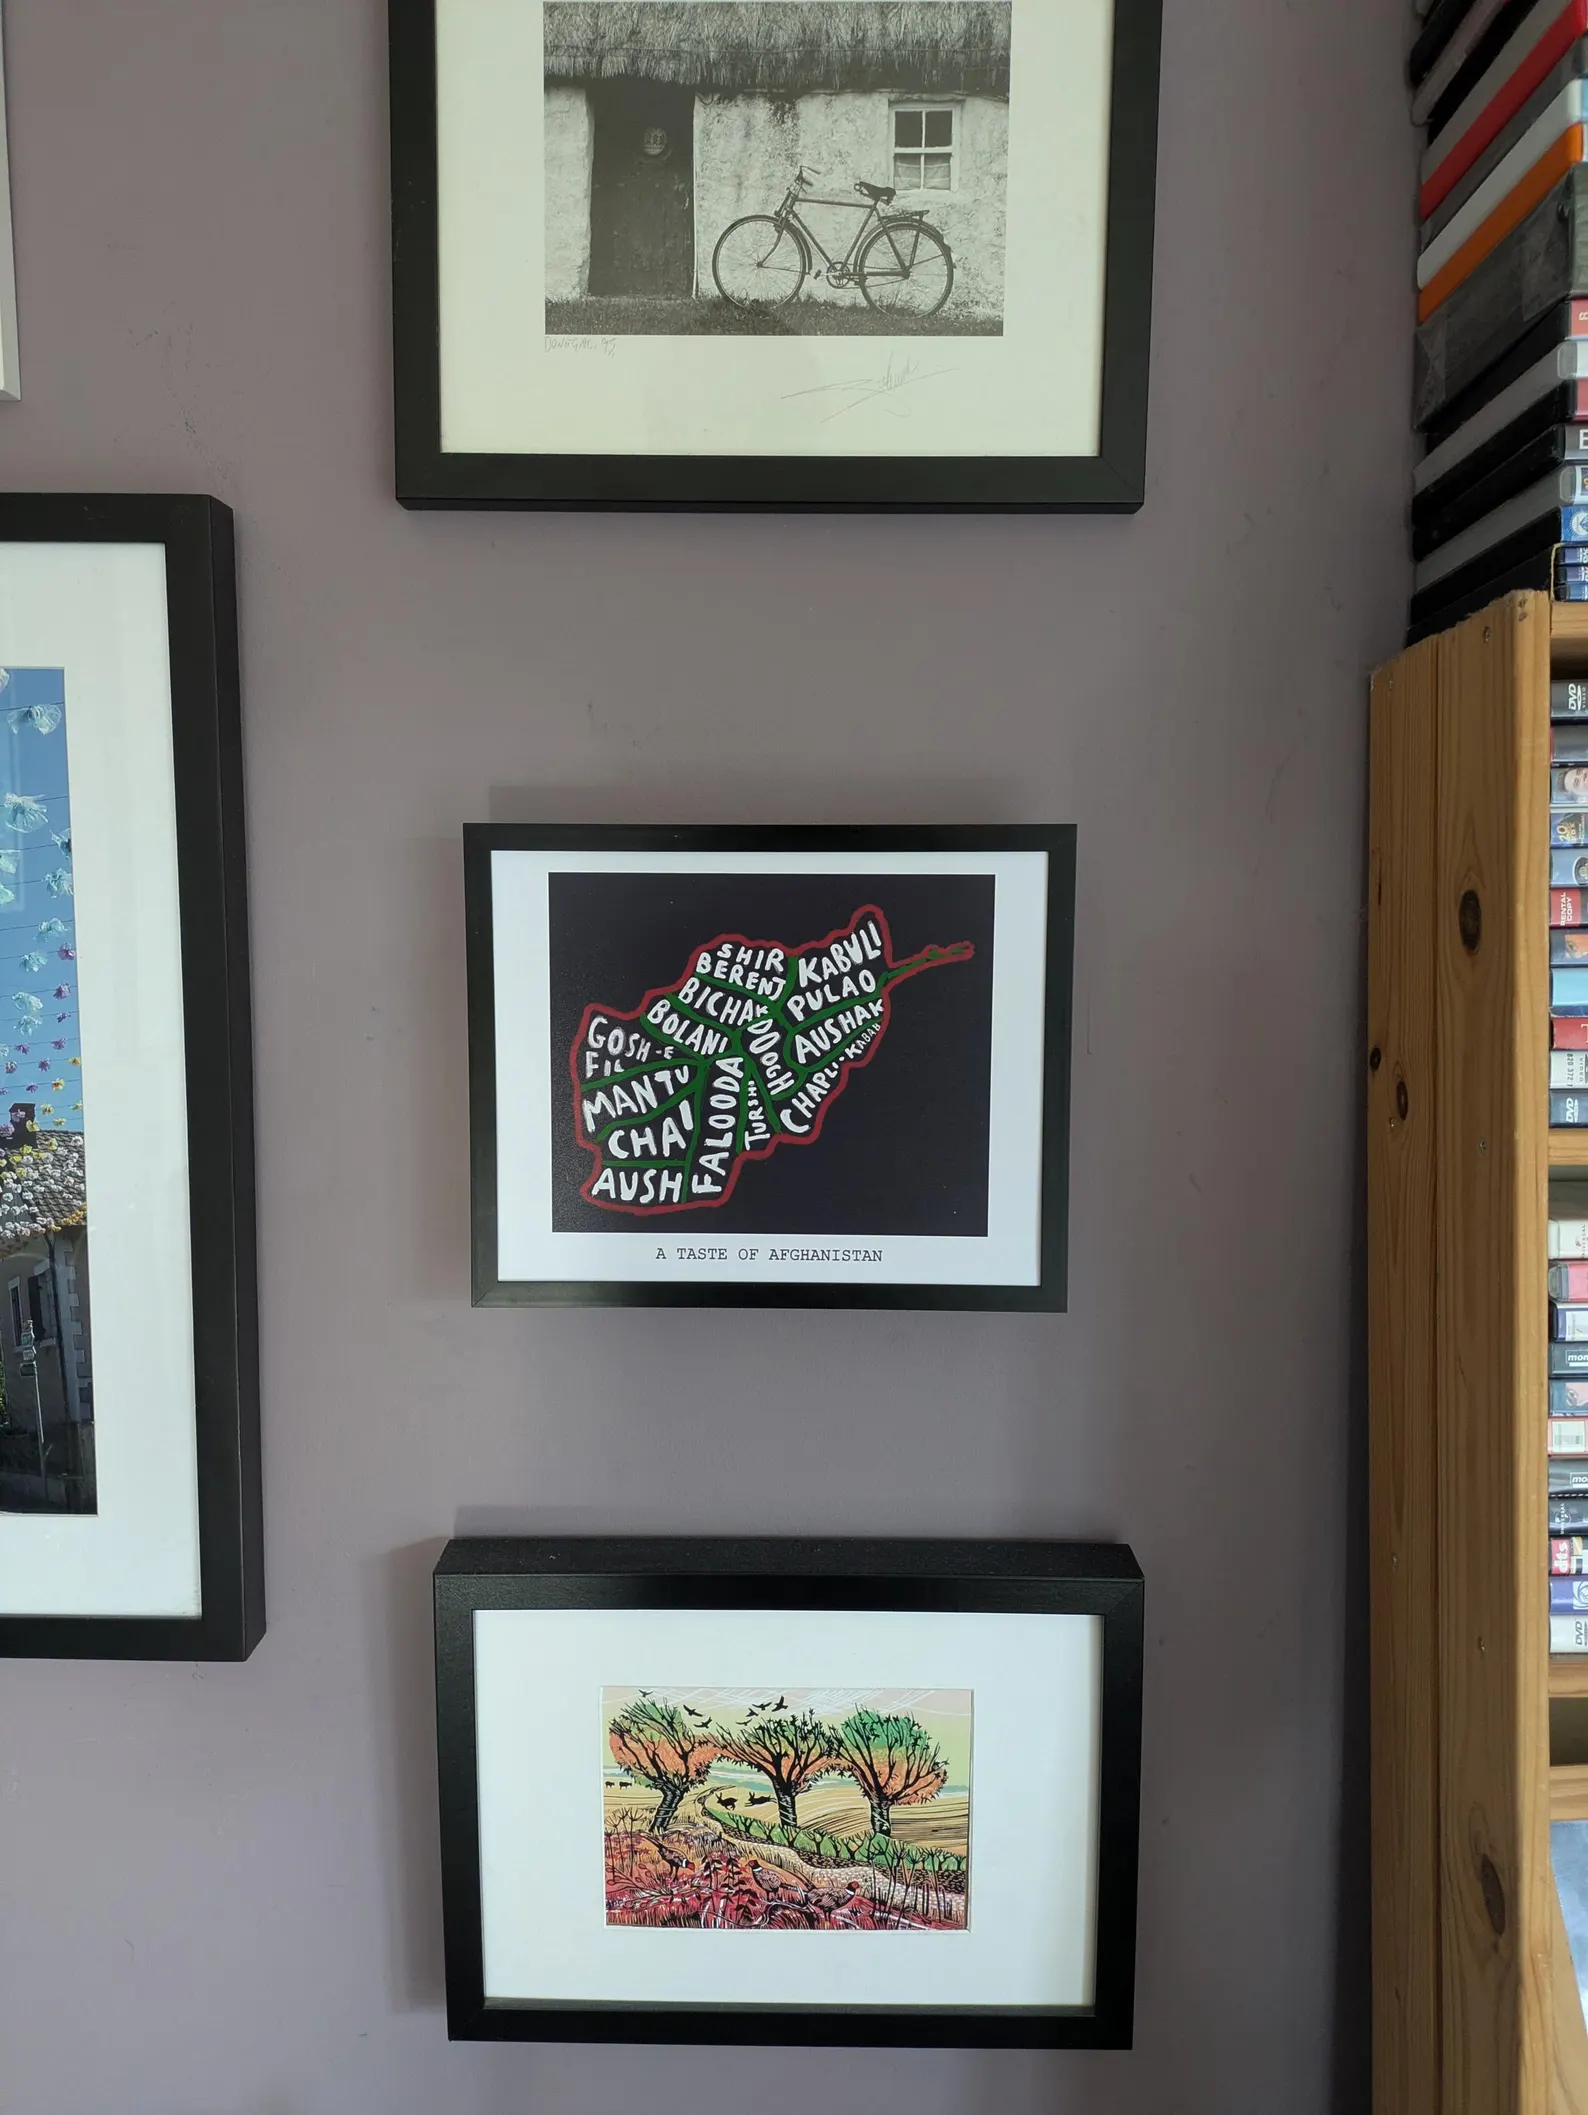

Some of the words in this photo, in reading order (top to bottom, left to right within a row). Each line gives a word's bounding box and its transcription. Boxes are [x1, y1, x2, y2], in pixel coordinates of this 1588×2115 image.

[1568, 683, 1577, 711] DVD
[695, 952, 787, 1001] BERENJ
[716, 943, 785, 973] SHIR
[798, 920, 882, 988] KABULI
[678, 977, 769, 1026] BICHAK
[786, 969, 876, 1021] PULAO
[647, 999, 728, 1056] BOLANI
[794, 998, 885, 1064] AUSHAK
[585, 1051, 625, 1078] FIL
[747, 1018, 795, 1096] DOOGH
[582, 1065, 690, 1133] MANTU
[744, 1080, 771, 1151] TURSHI
[1566, 1097, 1574, 1123] DVD
[608, 1100, 694, 1159] CHAI
[691, 1057, 744, 1194] FALOODA
[591, 1168, 683, 1203] AUSH
[655, 1248, 667, 1260] A
[677, 1248, 728, 1260] TASTE
[738, 1248, 759, 1260] OF
[768, 1249, 883, 1262] AFGHANISTAN
[1553, 1542, 1569, 1573] dts
[1575, 1621, 1584, 1646] DVD
